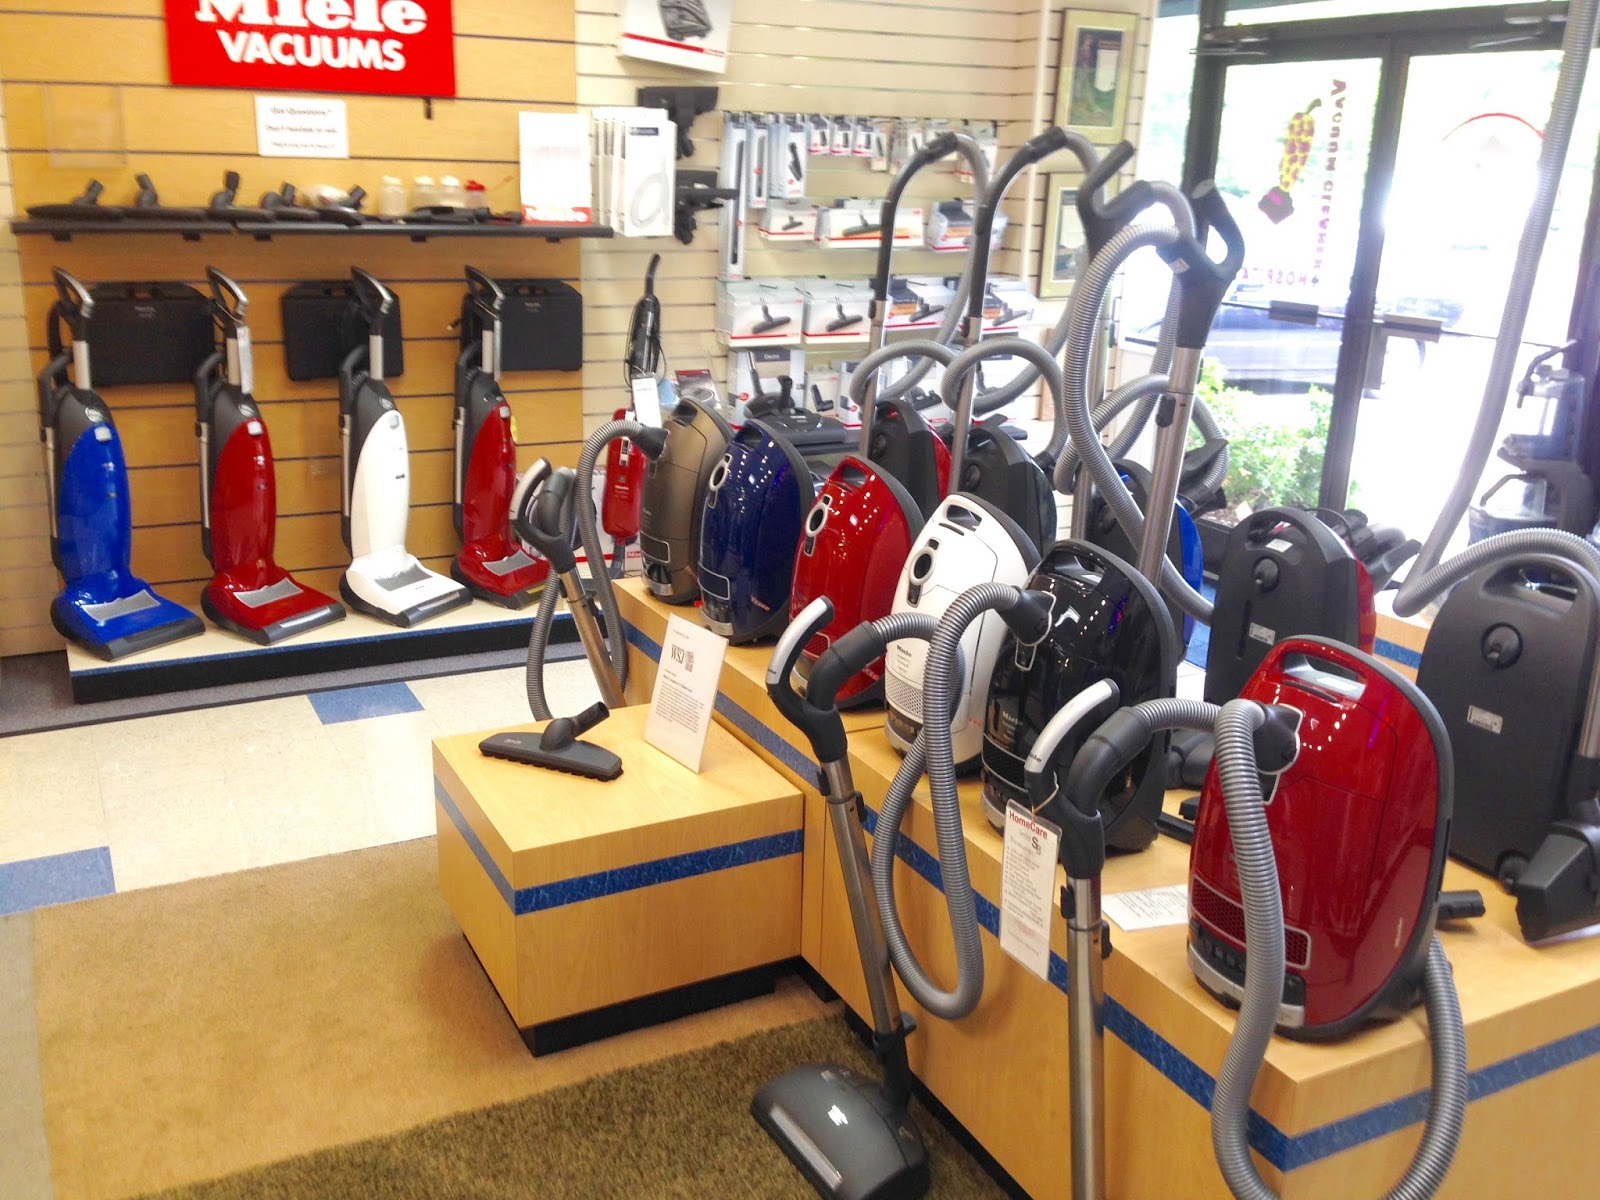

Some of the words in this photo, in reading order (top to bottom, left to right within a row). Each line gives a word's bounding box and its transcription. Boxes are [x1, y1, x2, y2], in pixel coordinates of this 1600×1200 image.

[195, 0, 428, 34] Miele
[215, 29, 406, 71] VACUUMS
[671, 645, 685, 664] WSJ
[1009, 810, 1048, 839] HomeCare
